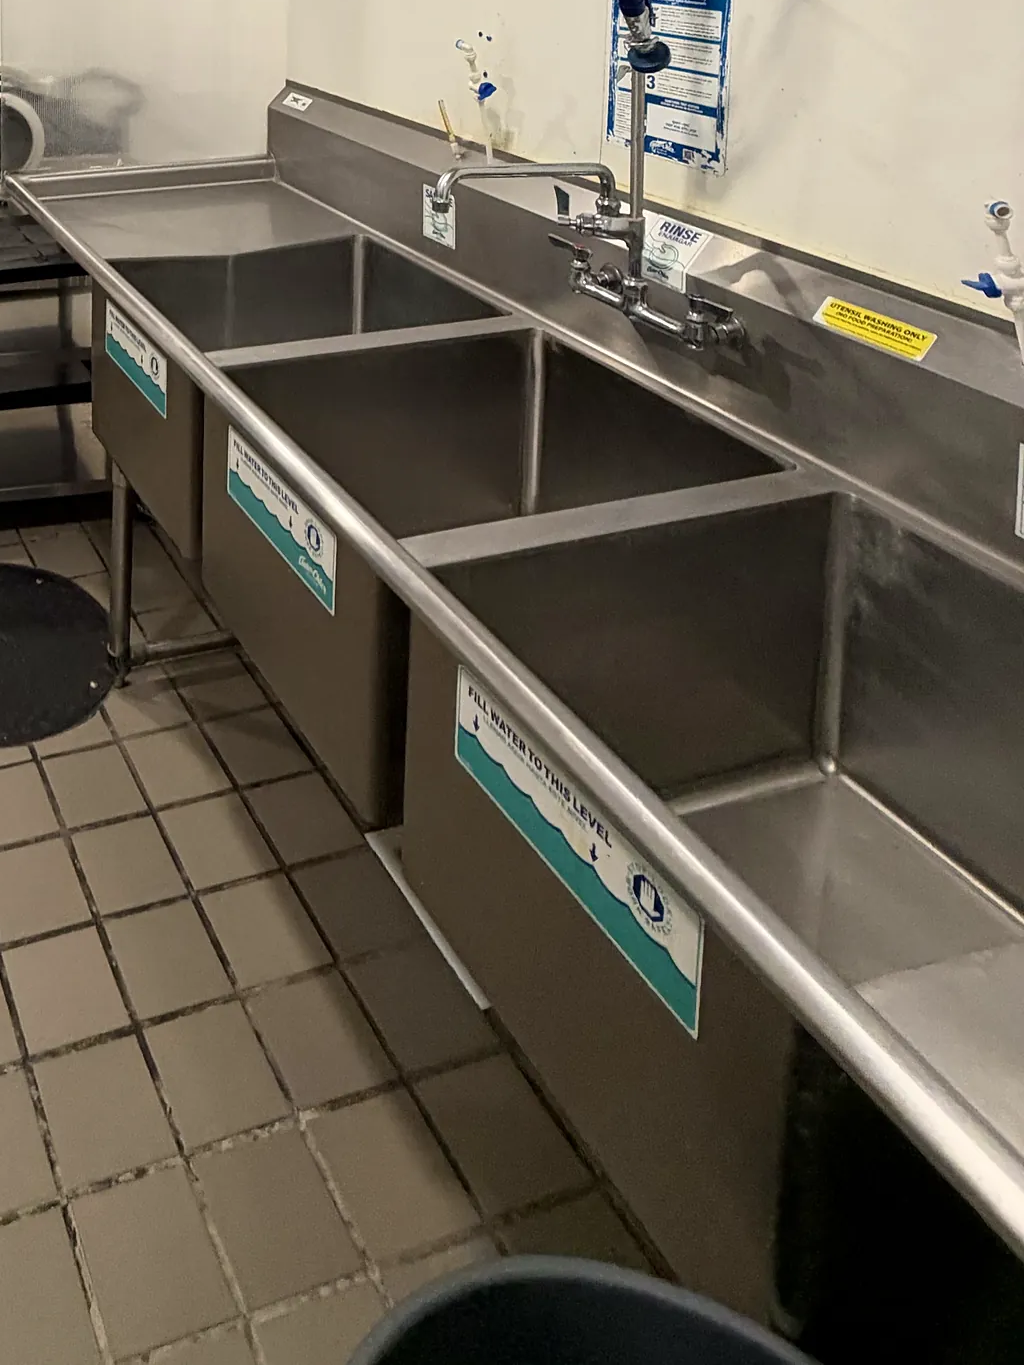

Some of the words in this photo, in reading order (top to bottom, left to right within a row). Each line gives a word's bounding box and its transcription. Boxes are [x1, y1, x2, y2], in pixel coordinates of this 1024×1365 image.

[646, 74, 656, 89] 3
[660, 221, 702, 243] RINSE
[830, 302, 862, 318] UTENSIL
[864, 314, 902, 333] WASHING
[904, 329, 928, 342] ONLY
[848, 315, 866, 325] FOOD
[244, 449, 261, 475] WATER
[281, 489, 299, 515] LEVEL
[468, 686, 489, 716] FILL
[491, 708, 526, 755] WATER
[528, 748, 542, 770] TO
[544, 764, 571, 802] THIS
[573, 797, 613, 849] LEVEL
